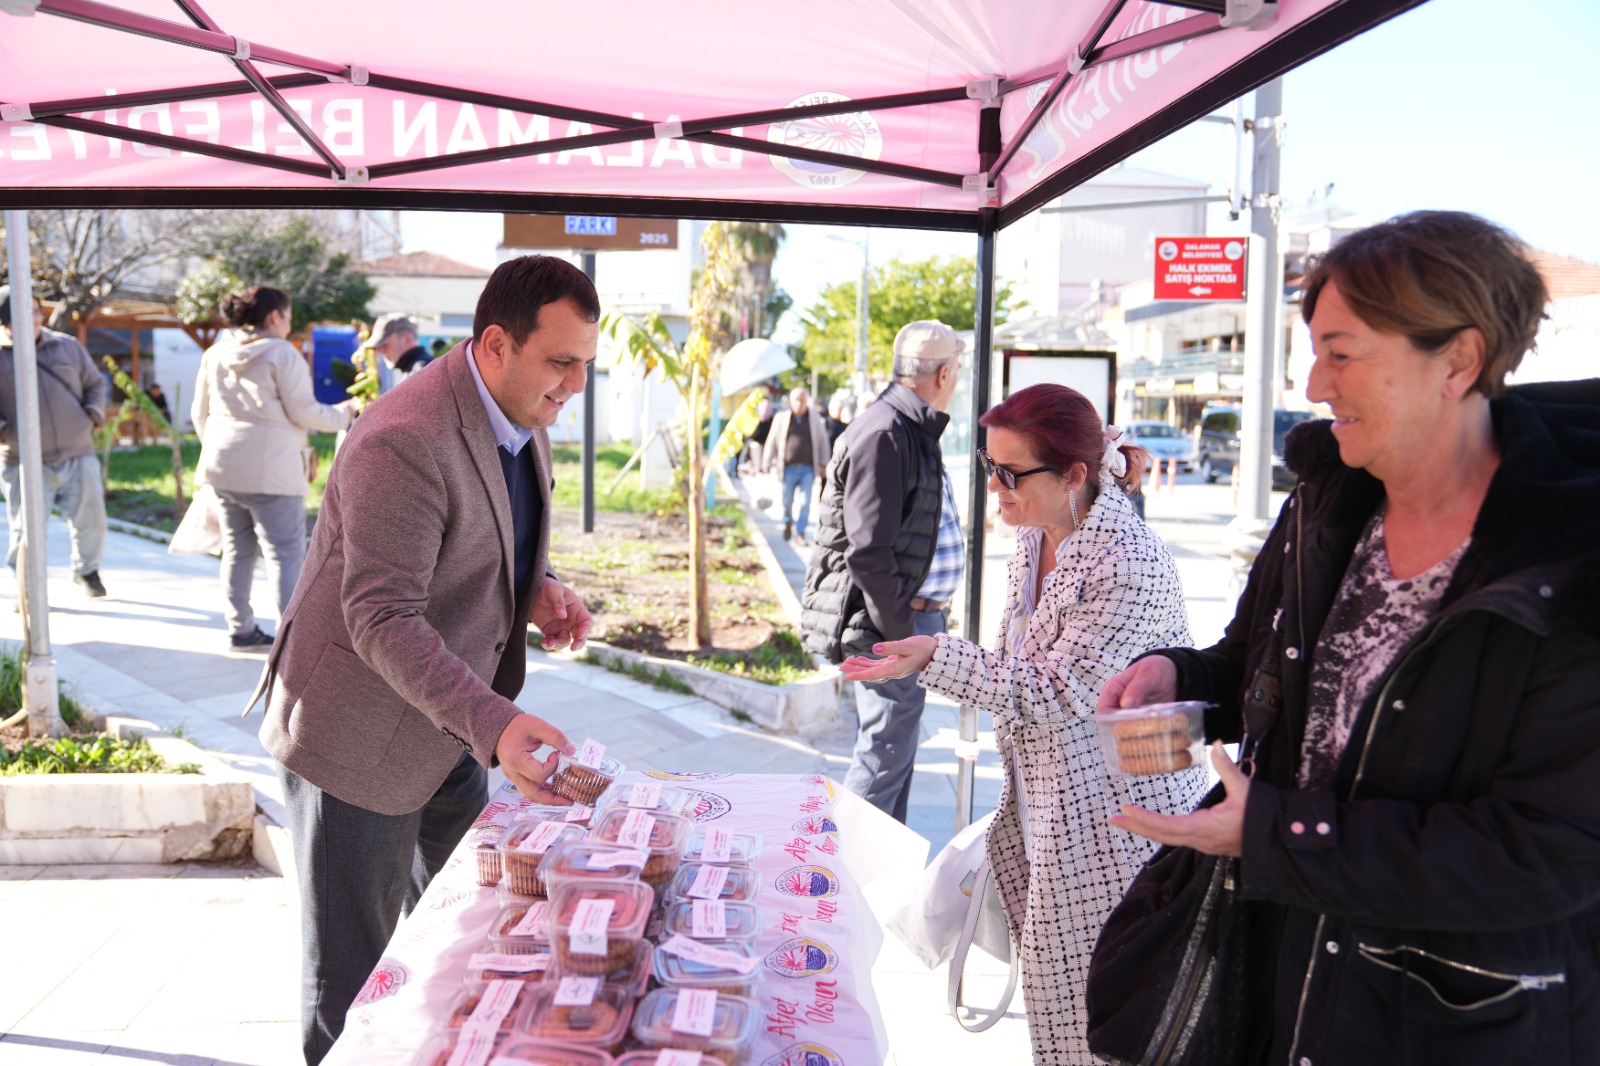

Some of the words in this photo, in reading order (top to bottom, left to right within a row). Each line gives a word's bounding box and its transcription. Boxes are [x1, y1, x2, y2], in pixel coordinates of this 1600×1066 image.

[639, 233, 668, 244] 2025
[1184, 243, 1221, 251] DALAMAN
[1182, 250, 1223, 259] BELEDİYESİ
[1169, 263, 1196, 273] HALK
[1197, 263, 1232, 273] EKMEK
[1164, 274, 1192, 285] SATIŞ
[1194, 274, 1237, 283] NOKTASI
